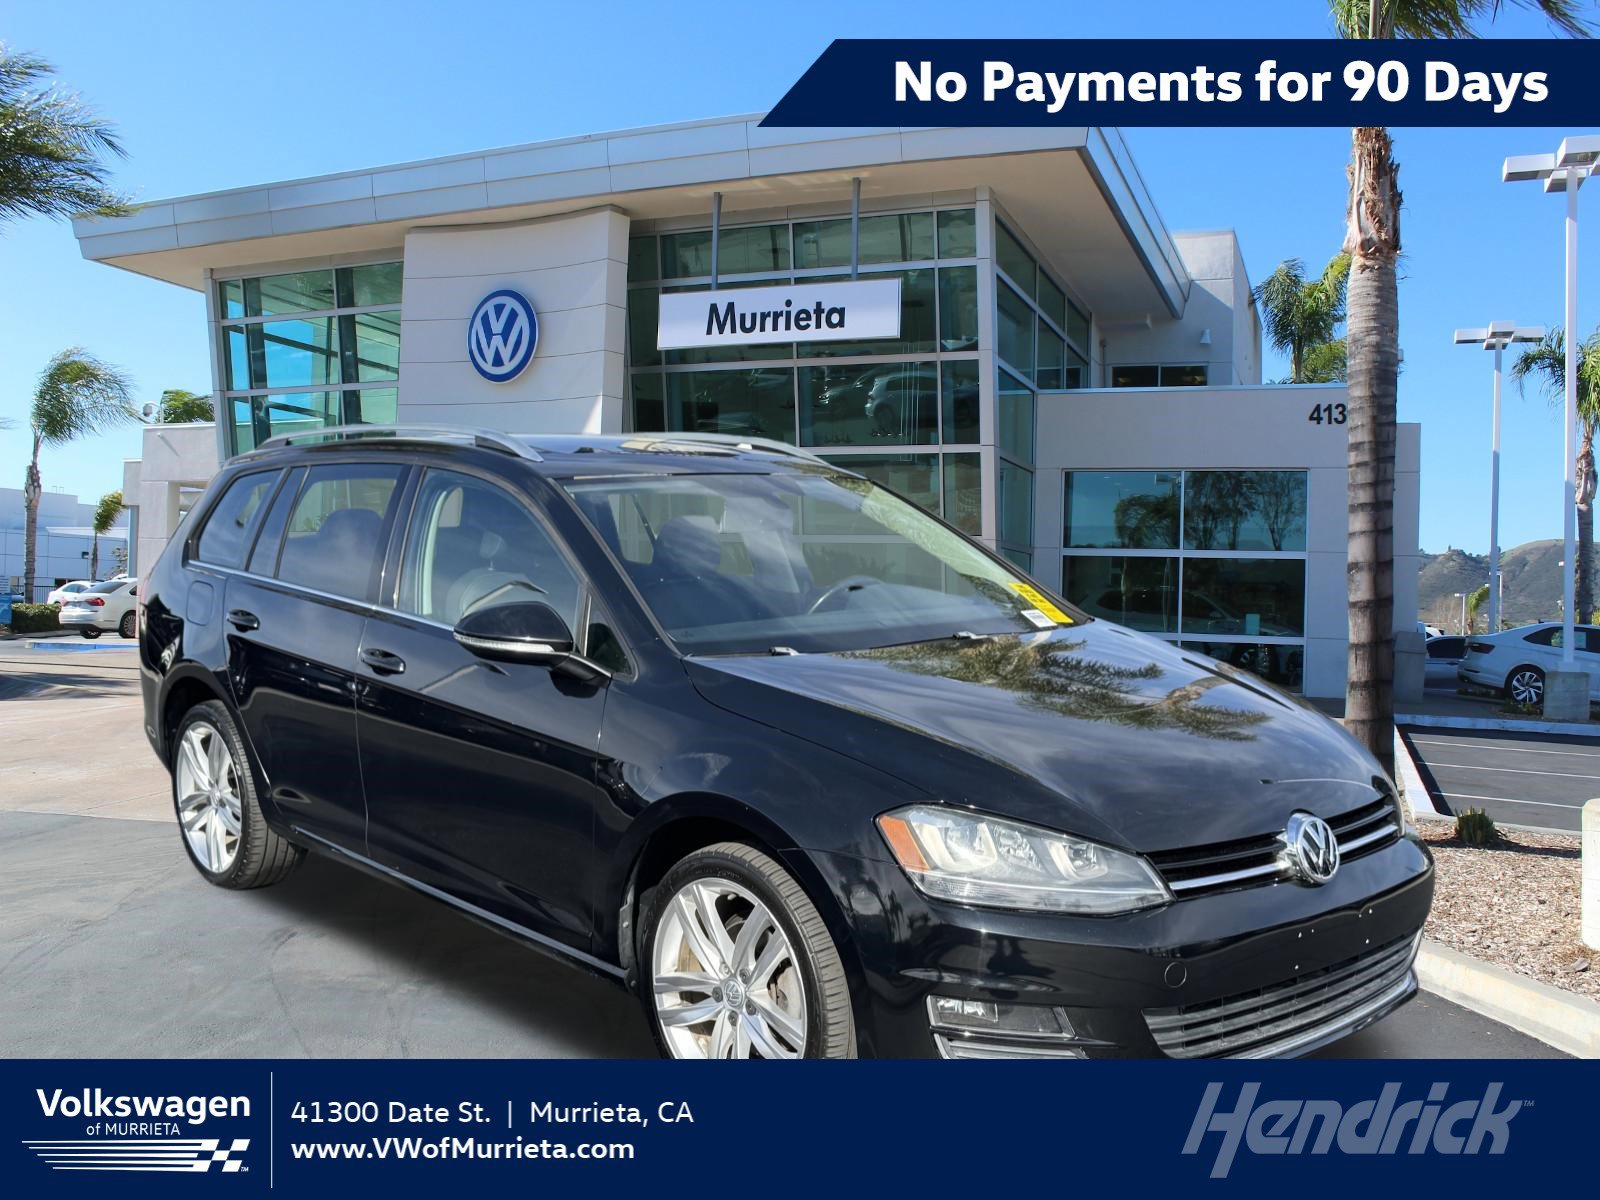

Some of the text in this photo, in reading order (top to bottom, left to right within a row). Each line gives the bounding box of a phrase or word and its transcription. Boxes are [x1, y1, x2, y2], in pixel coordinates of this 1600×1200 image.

[470, 294, 531, 376] VW
[706, 299, 846, 336] Murrieta
[1308, 403, 1347, 425] 413
[1298, 816, 1340, 881] VW
